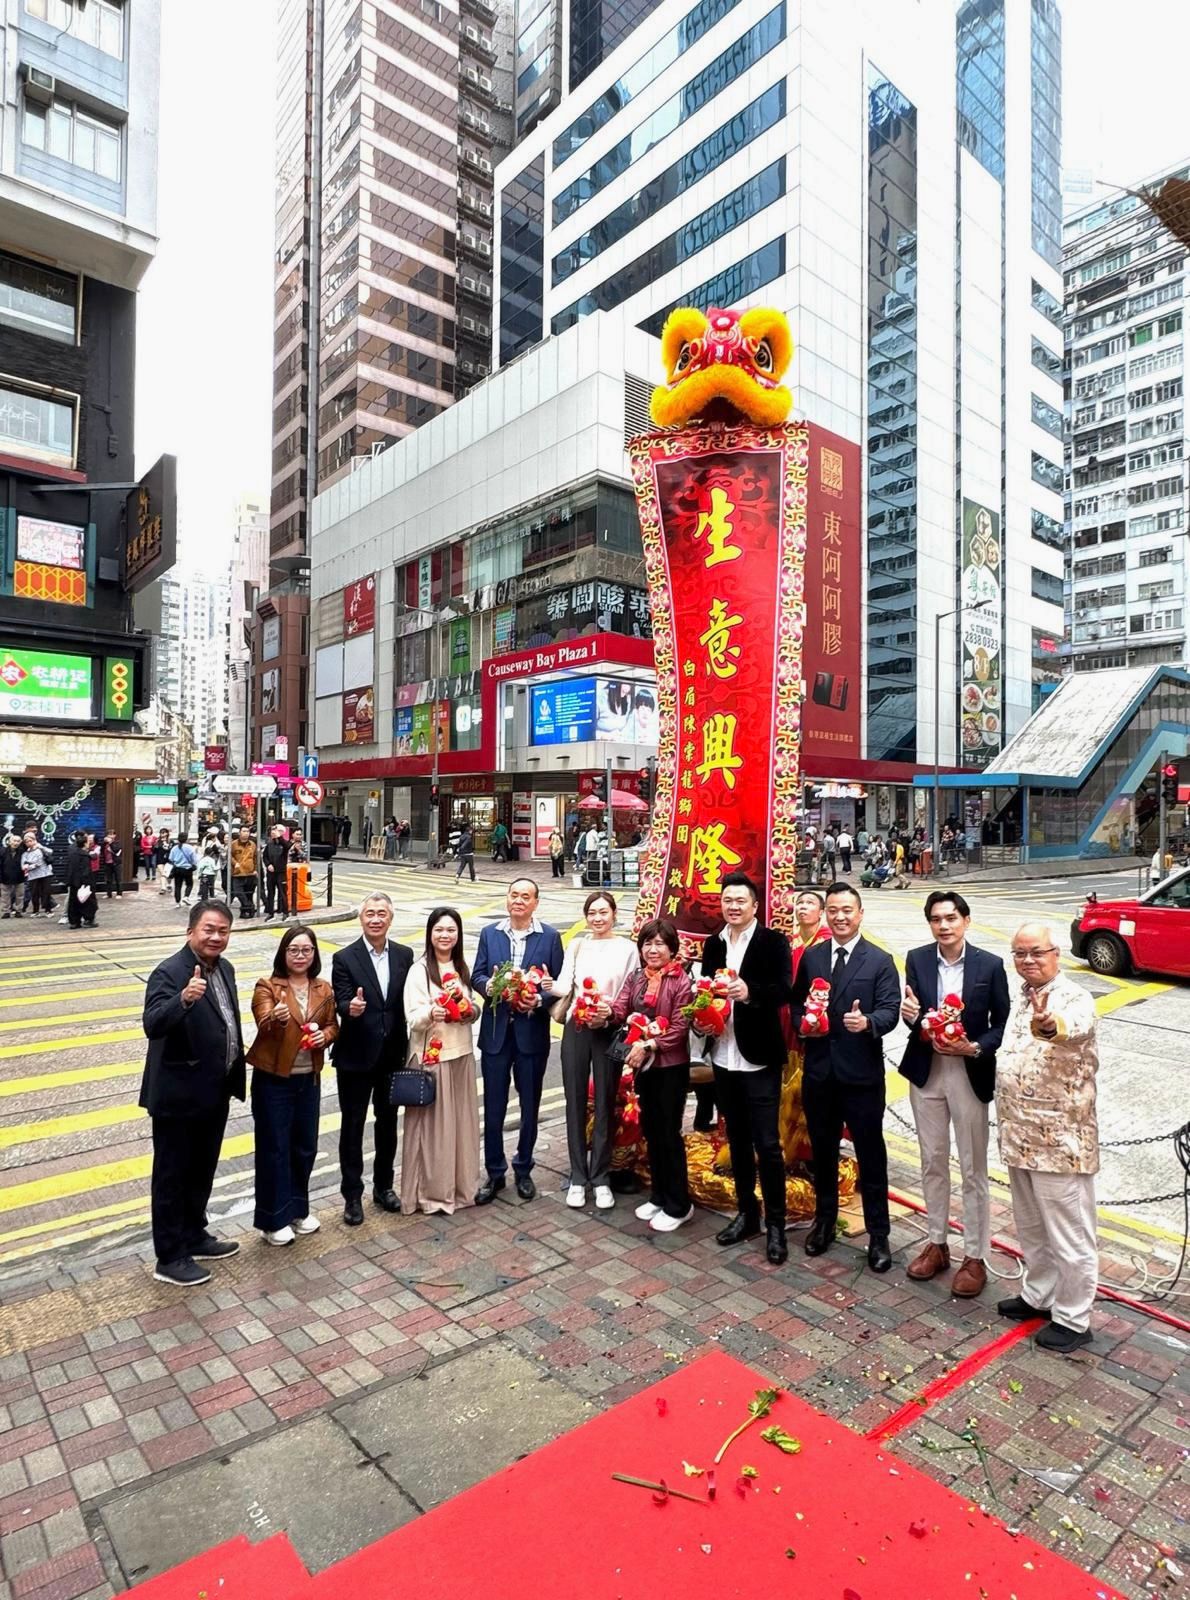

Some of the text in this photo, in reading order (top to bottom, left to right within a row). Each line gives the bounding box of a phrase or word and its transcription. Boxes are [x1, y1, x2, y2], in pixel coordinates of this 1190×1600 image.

[822, 510, 843, 656] 東阿阿膠
[573, 604, 592, 614] JIAN
[488, 641, 597, 677] Causeway Bay Plaza 1
[685, 487, 745, 894] 生意興隆
[246, 1500, 271, 1528] HCL
